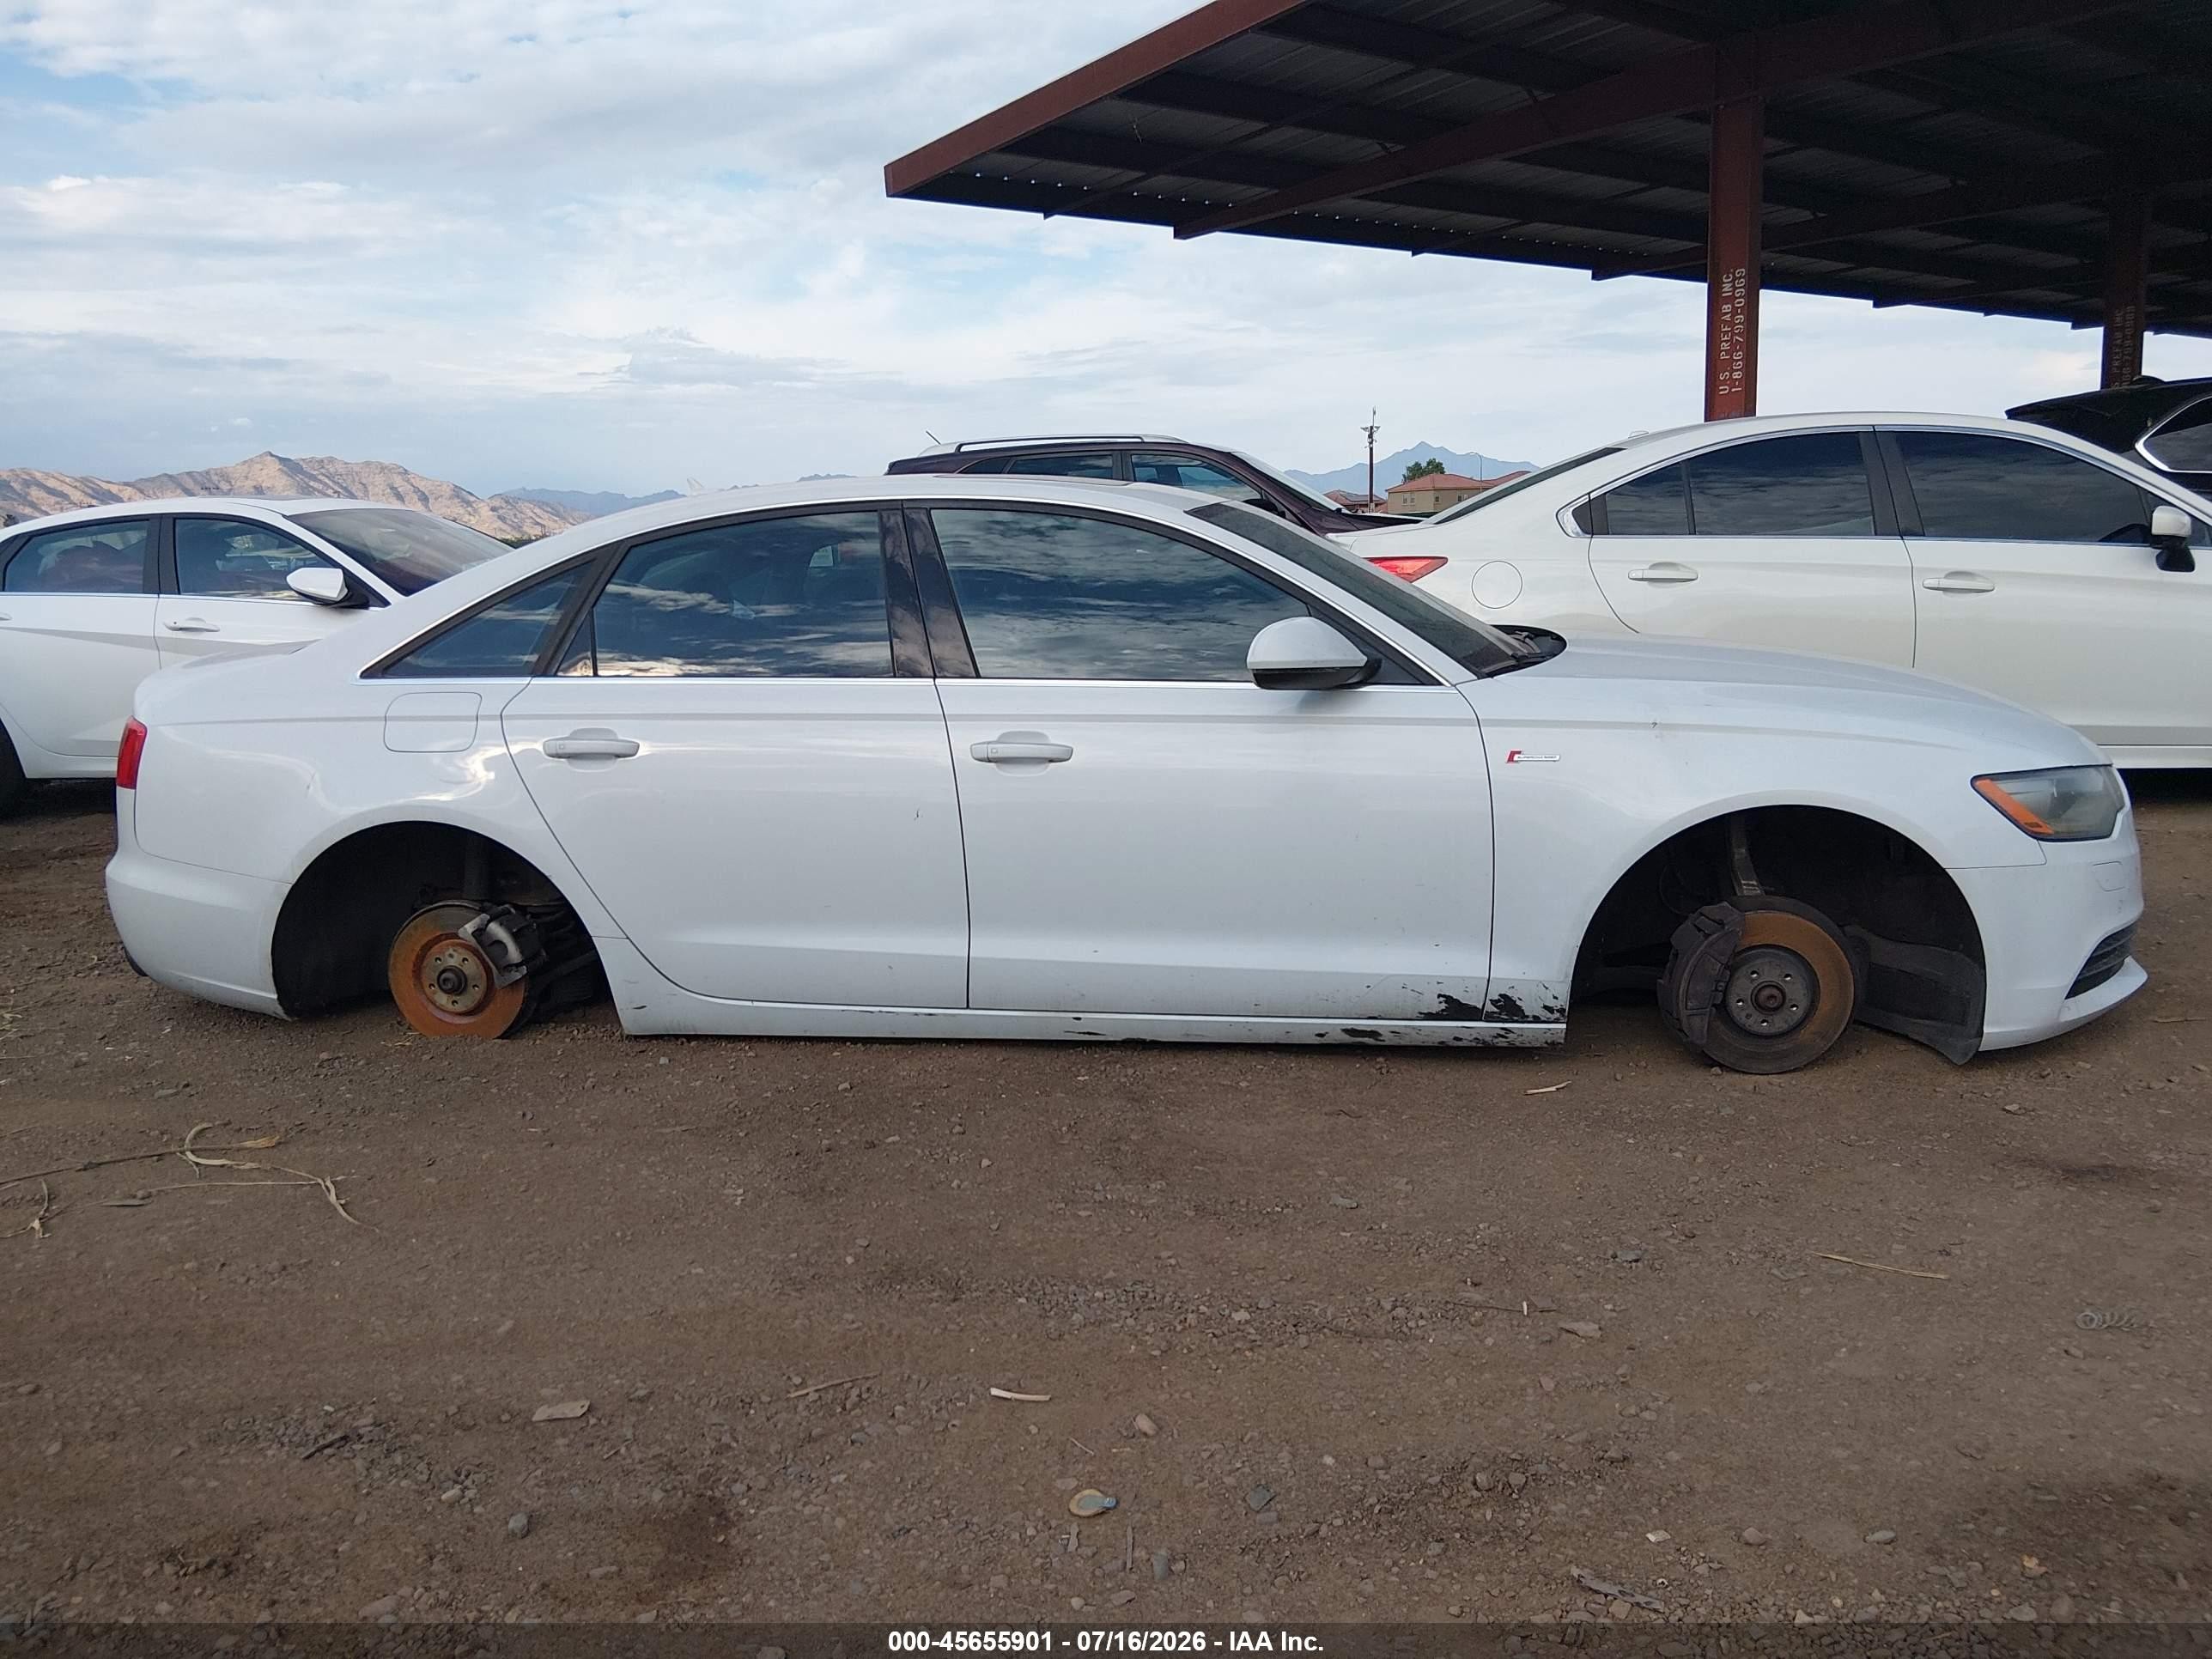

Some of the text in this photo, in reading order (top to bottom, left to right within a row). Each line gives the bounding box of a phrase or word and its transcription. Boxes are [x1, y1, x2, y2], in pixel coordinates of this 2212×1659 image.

[1719, 268, 1734, 395] U.S. PREFAB INC.
[1731, 268, 1746, 392] 1-866-799-0969
